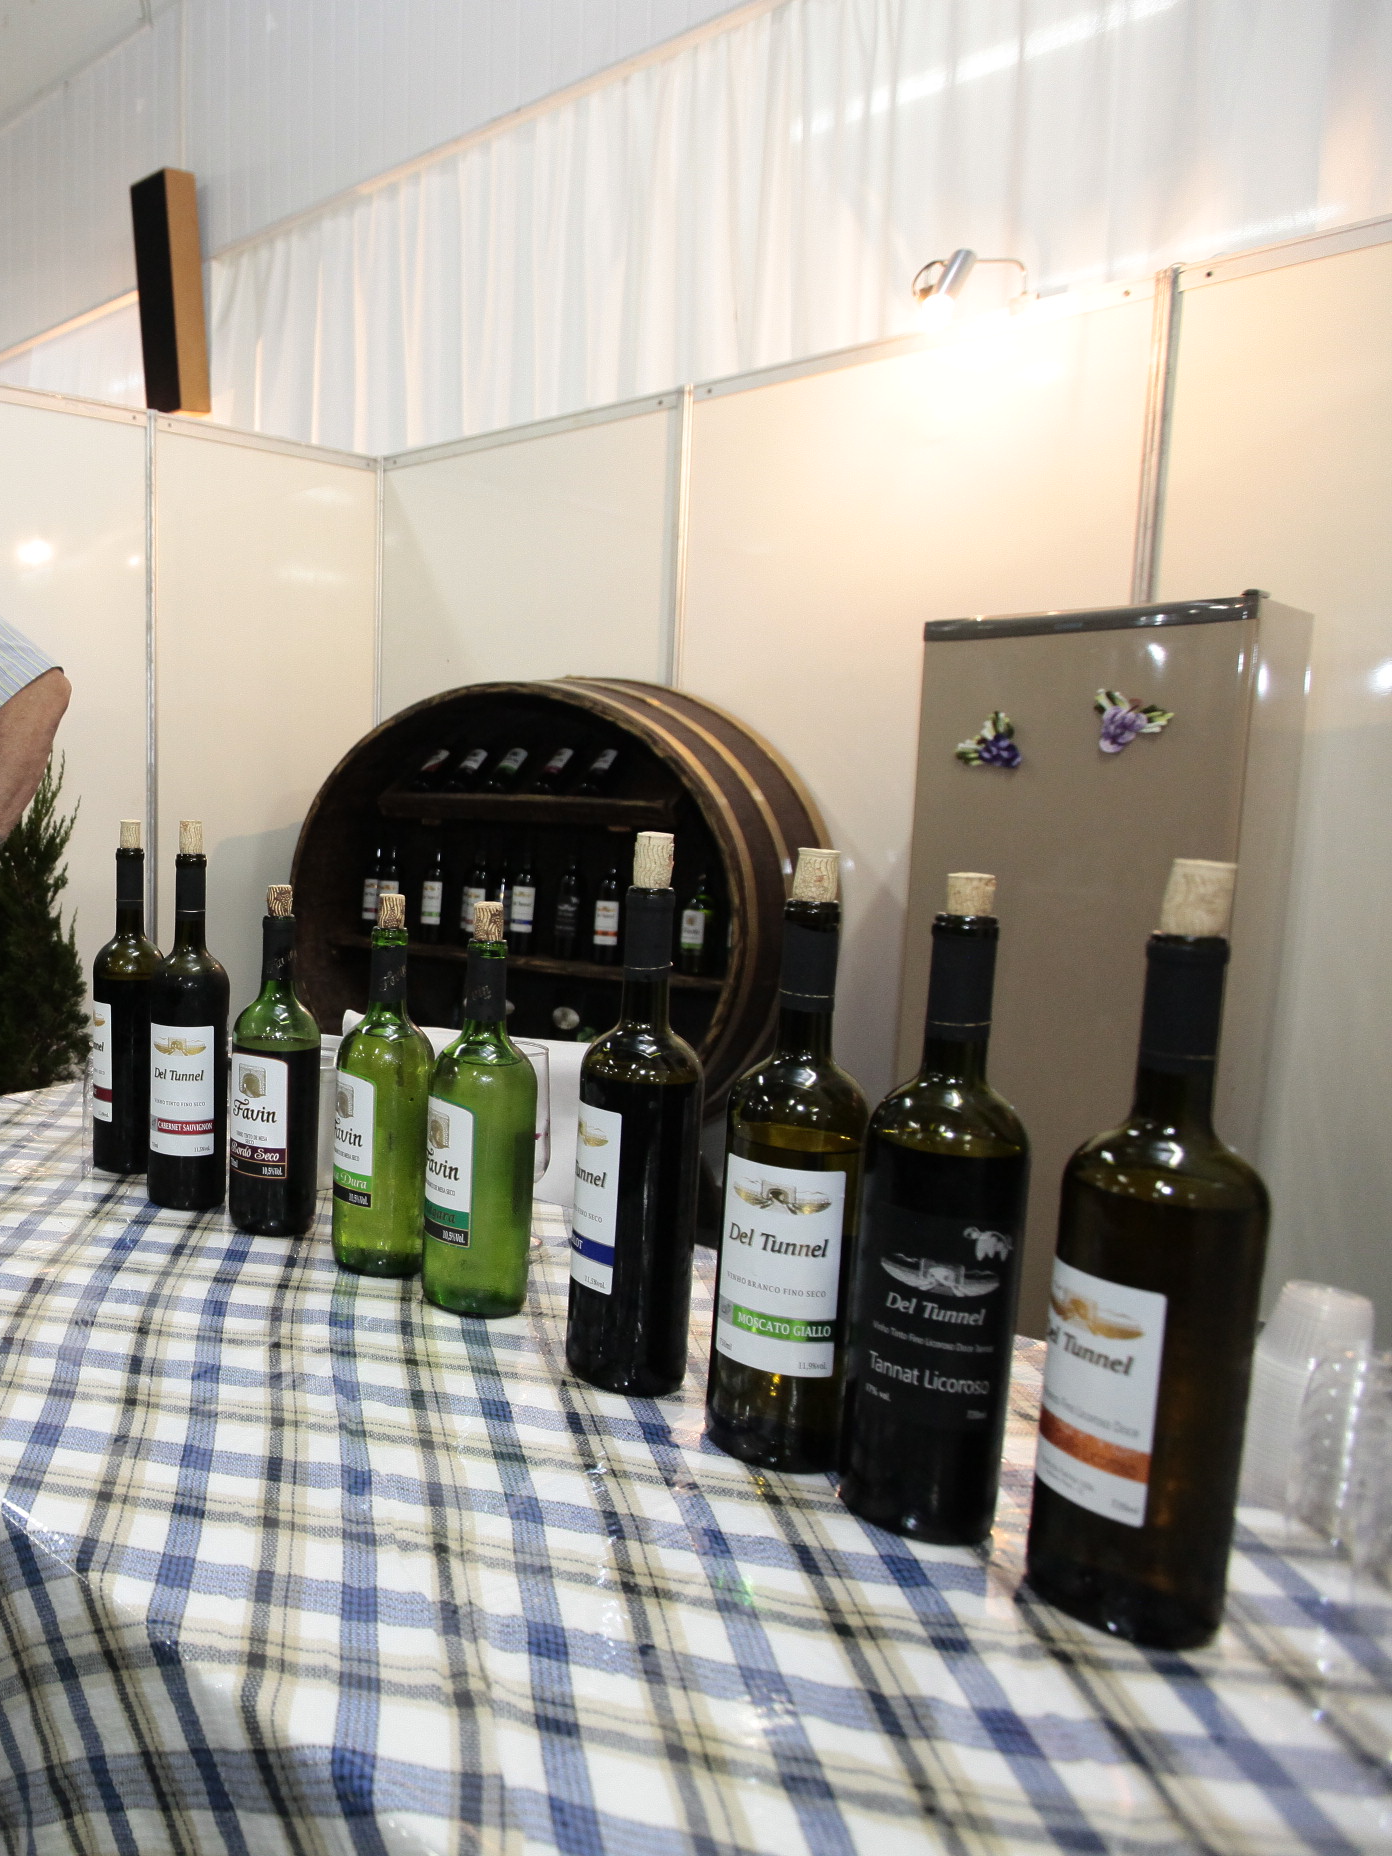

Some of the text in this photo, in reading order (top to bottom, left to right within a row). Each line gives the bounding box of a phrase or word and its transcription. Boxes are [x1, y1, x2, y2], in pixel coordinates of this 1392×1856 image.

[93, 1041, 105, 1053] nnel
[154, 1066, 205, 1082] Del Tunnel
[232, 1098, 278, 1124] Favin
[157, 1120, 213, 1132] CABERNET SAUVIGNON
[254, 1148, 280, 1162] Seco
[340, 1172, 368, 1190] Dura
[588, 1210, 603, 1223] SECO
[729, 1221, 830, 1258] Del Tunnel
[727, 1271, 827, 1298] VINHO BRANCO FINO SECO
[886, 1291, 986, 1326] Del Tunnel
[737, 1311, 831, 1338] MOSCATO GIALLO
[1063, 1332, 1136, 1377] Tunnel
[869, 1349, 990, 1395] Tannat Licoroso
